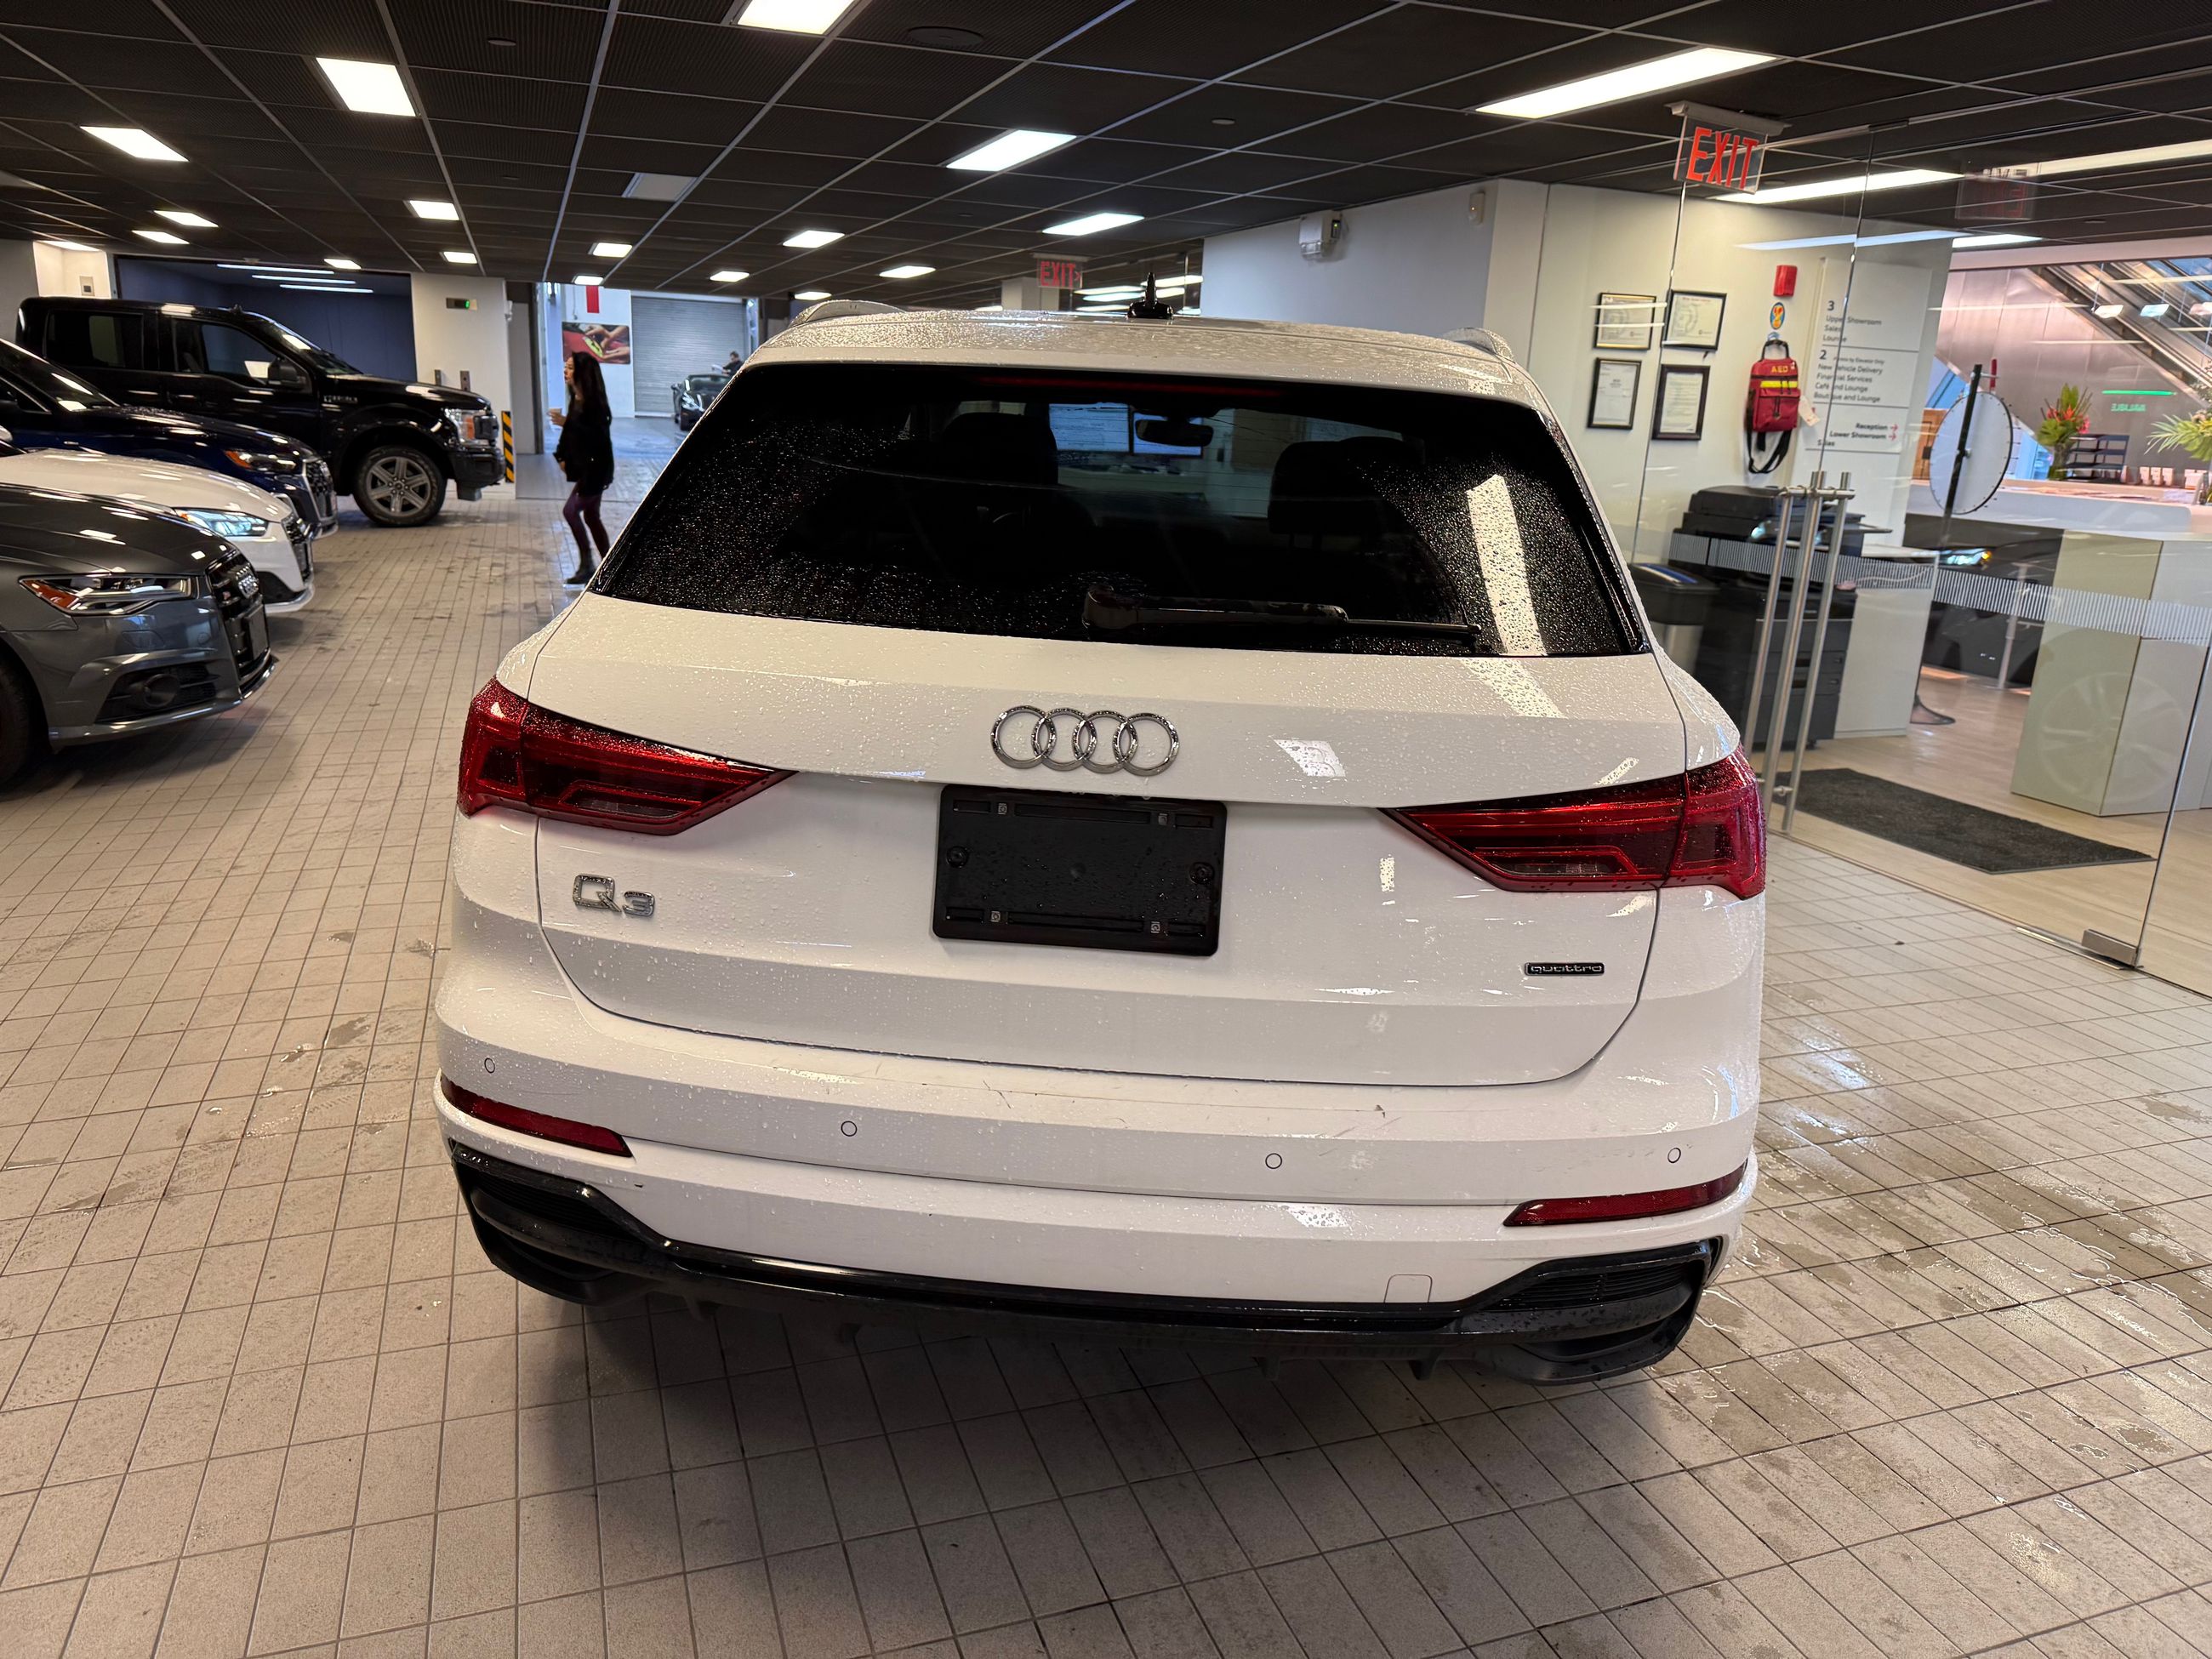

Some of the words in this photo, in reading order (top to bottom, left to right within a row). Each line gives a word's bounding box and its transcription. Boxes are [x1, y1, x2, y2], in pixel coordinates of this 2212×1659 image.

[1686, 127, 1759, 191] EXIT
[1040, 260, 1076, 288] EXIT
[1827, 300, 1835, 311] 3
[1826, 315, 1844, 323] Uppe
[1847, 316, 1882, 325] Showroom
[1819, 350, 1827, 360] 2
[1771, 365, 1788, 373] AED
[1857, 366, 1883, 375] Delivery
[1816, 373, 1845, 381] Finanial
[1847, 374, 1873, 383] Services
[1814, 392, 1842, 401] Boutque
[1857, 394, 1880, 403] Lounge
[573, 873, 655, 917] Q3
[1531, 965, 1603, 974] quattro
